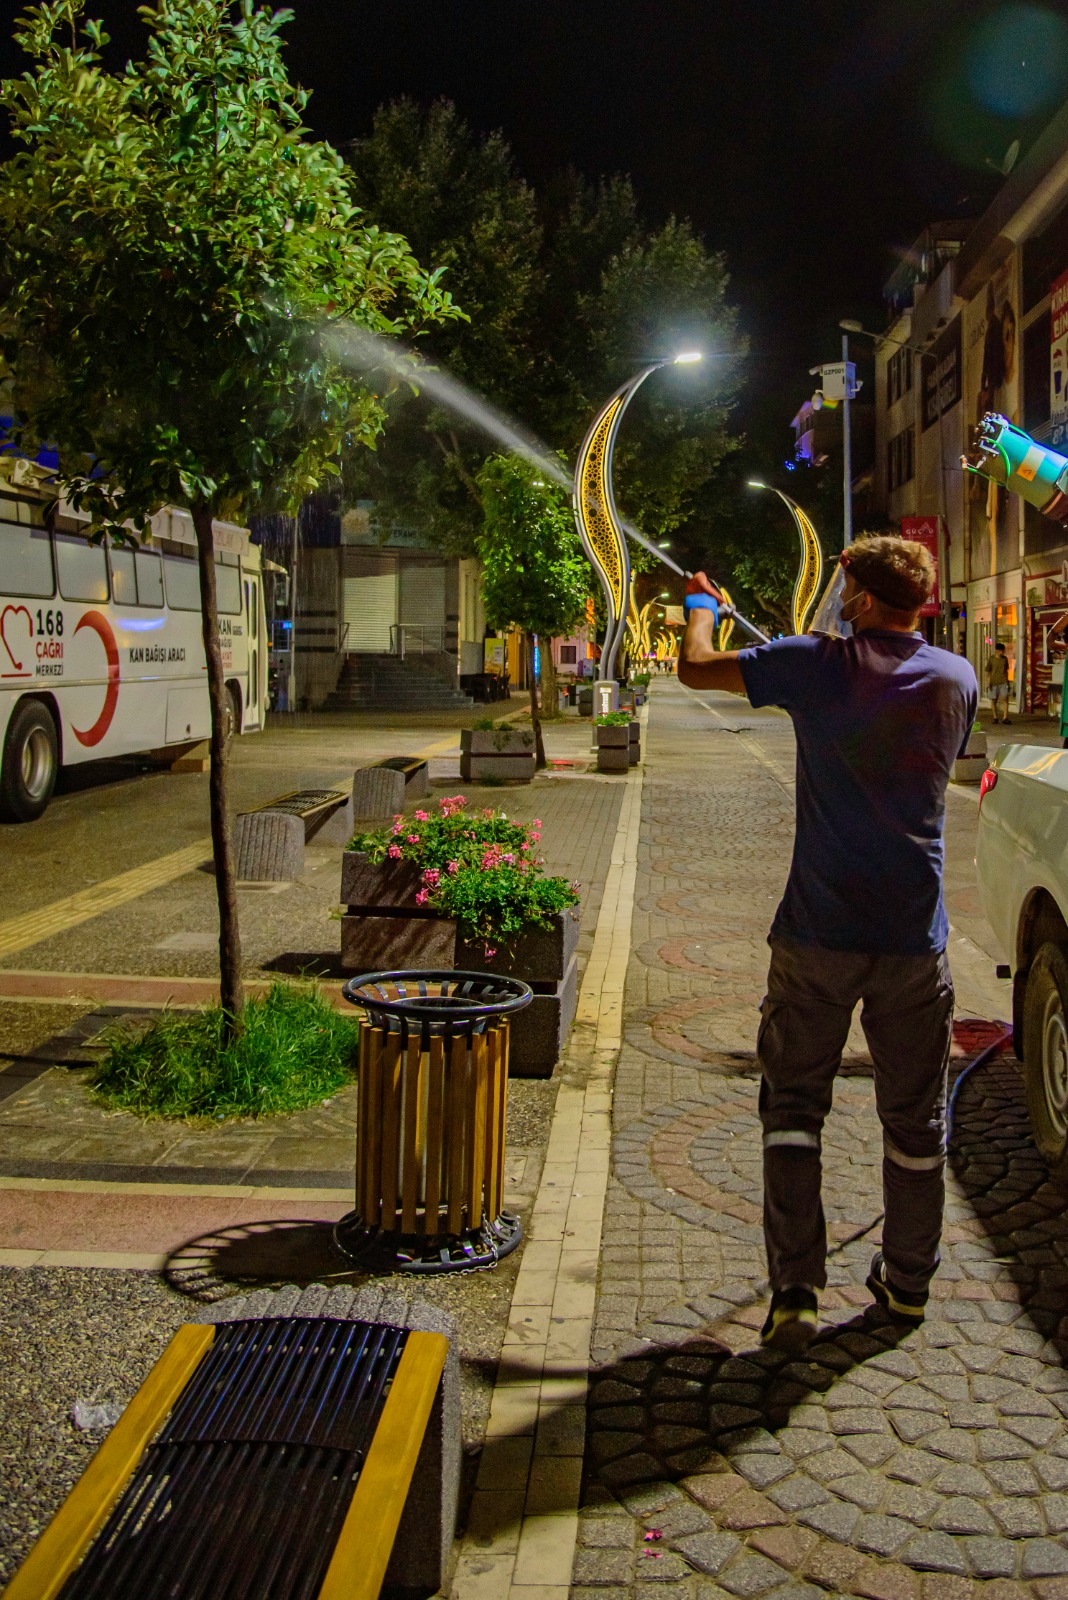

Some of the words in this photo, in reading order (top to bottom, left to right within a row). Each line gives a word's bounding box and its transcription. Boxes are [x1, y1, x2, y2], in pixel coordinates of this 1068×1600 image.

[36, 608, 64, 637] 168
[218, 619, 232, 635] KAN
[35, 637, 64, 663] ÇAĞRI
[129, 647, 144, 663] KAN
[145, 645, 167, 664] BAĞIŞI
[167, 647, 186, 662] ARACI
[35, 663, 64, 677] MERKEZİ
